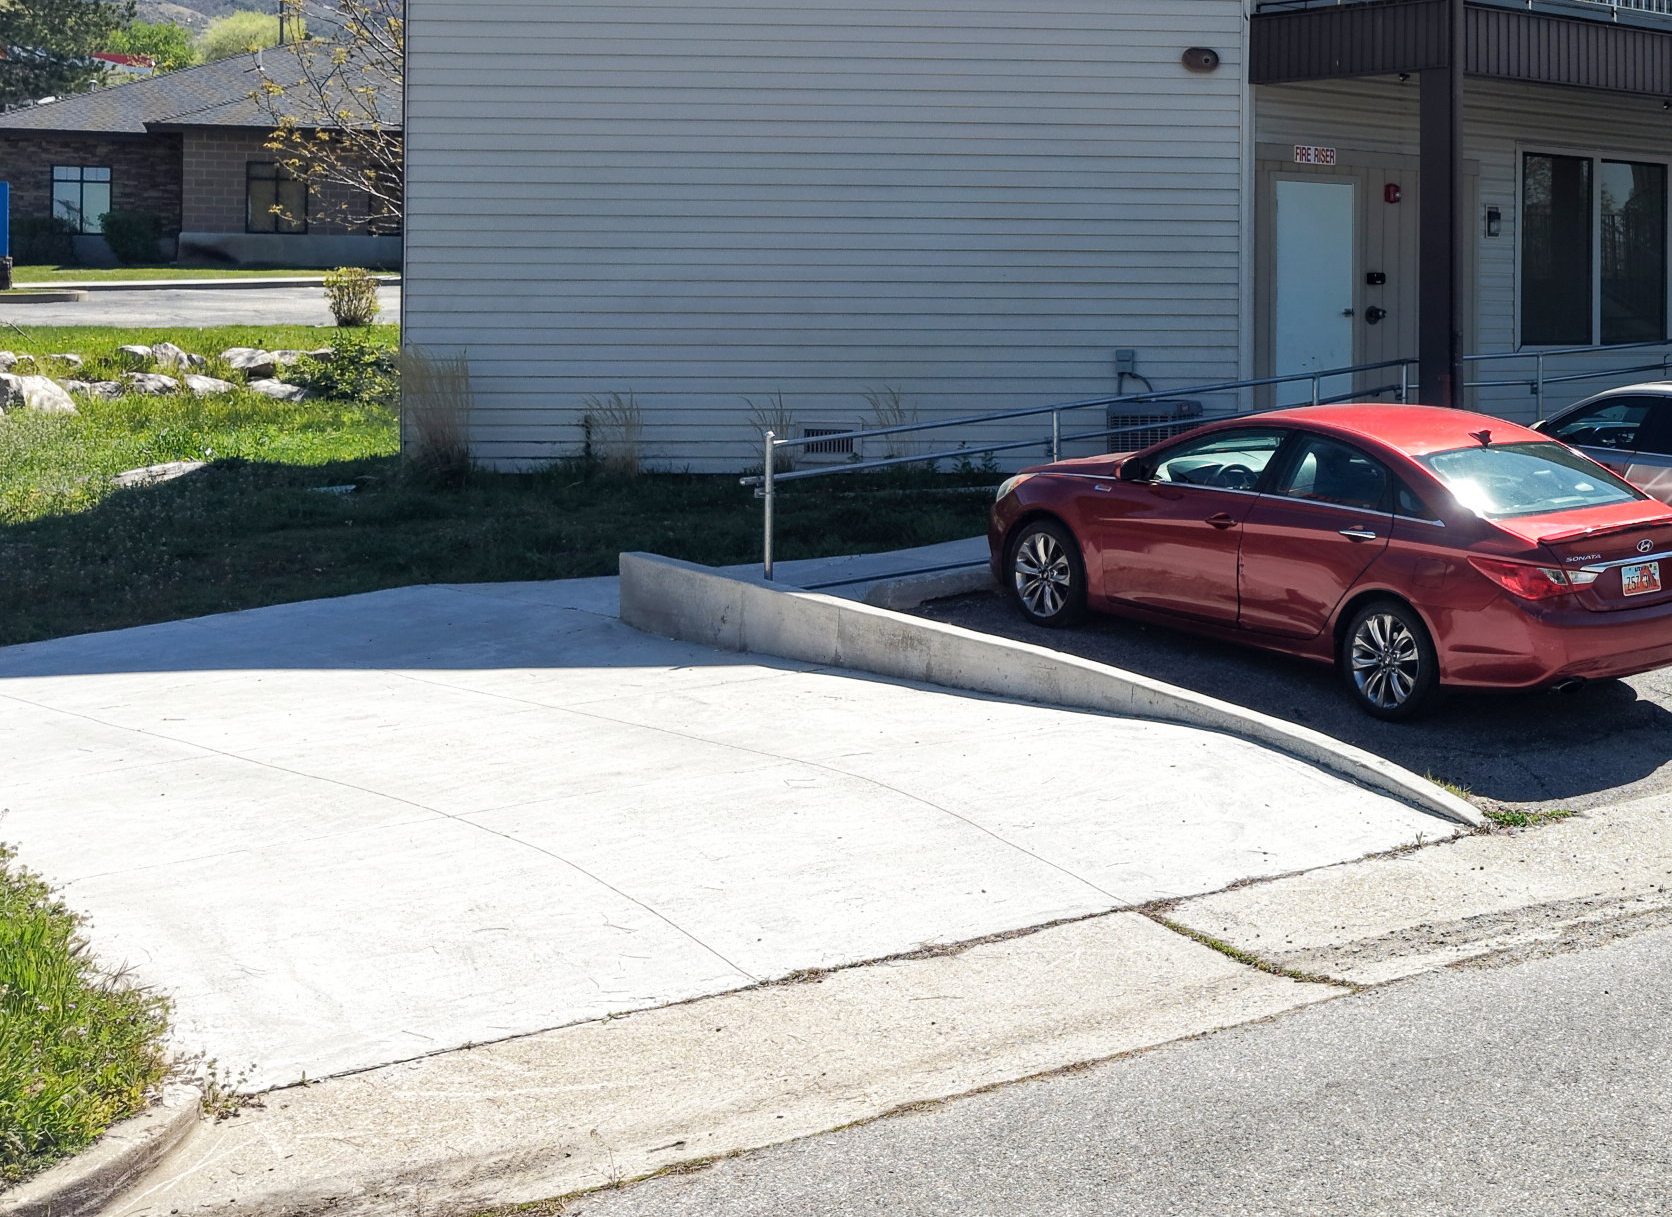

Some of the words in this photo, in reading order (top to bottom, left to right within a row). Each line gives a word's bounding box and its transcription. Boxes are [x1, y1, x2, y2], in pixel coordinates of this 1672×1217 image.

[1295, 146, 1311, 162] FIRE
[1314, 148, 1334, 164] RISER
[1565, 553, 1602, 563] SONATA
